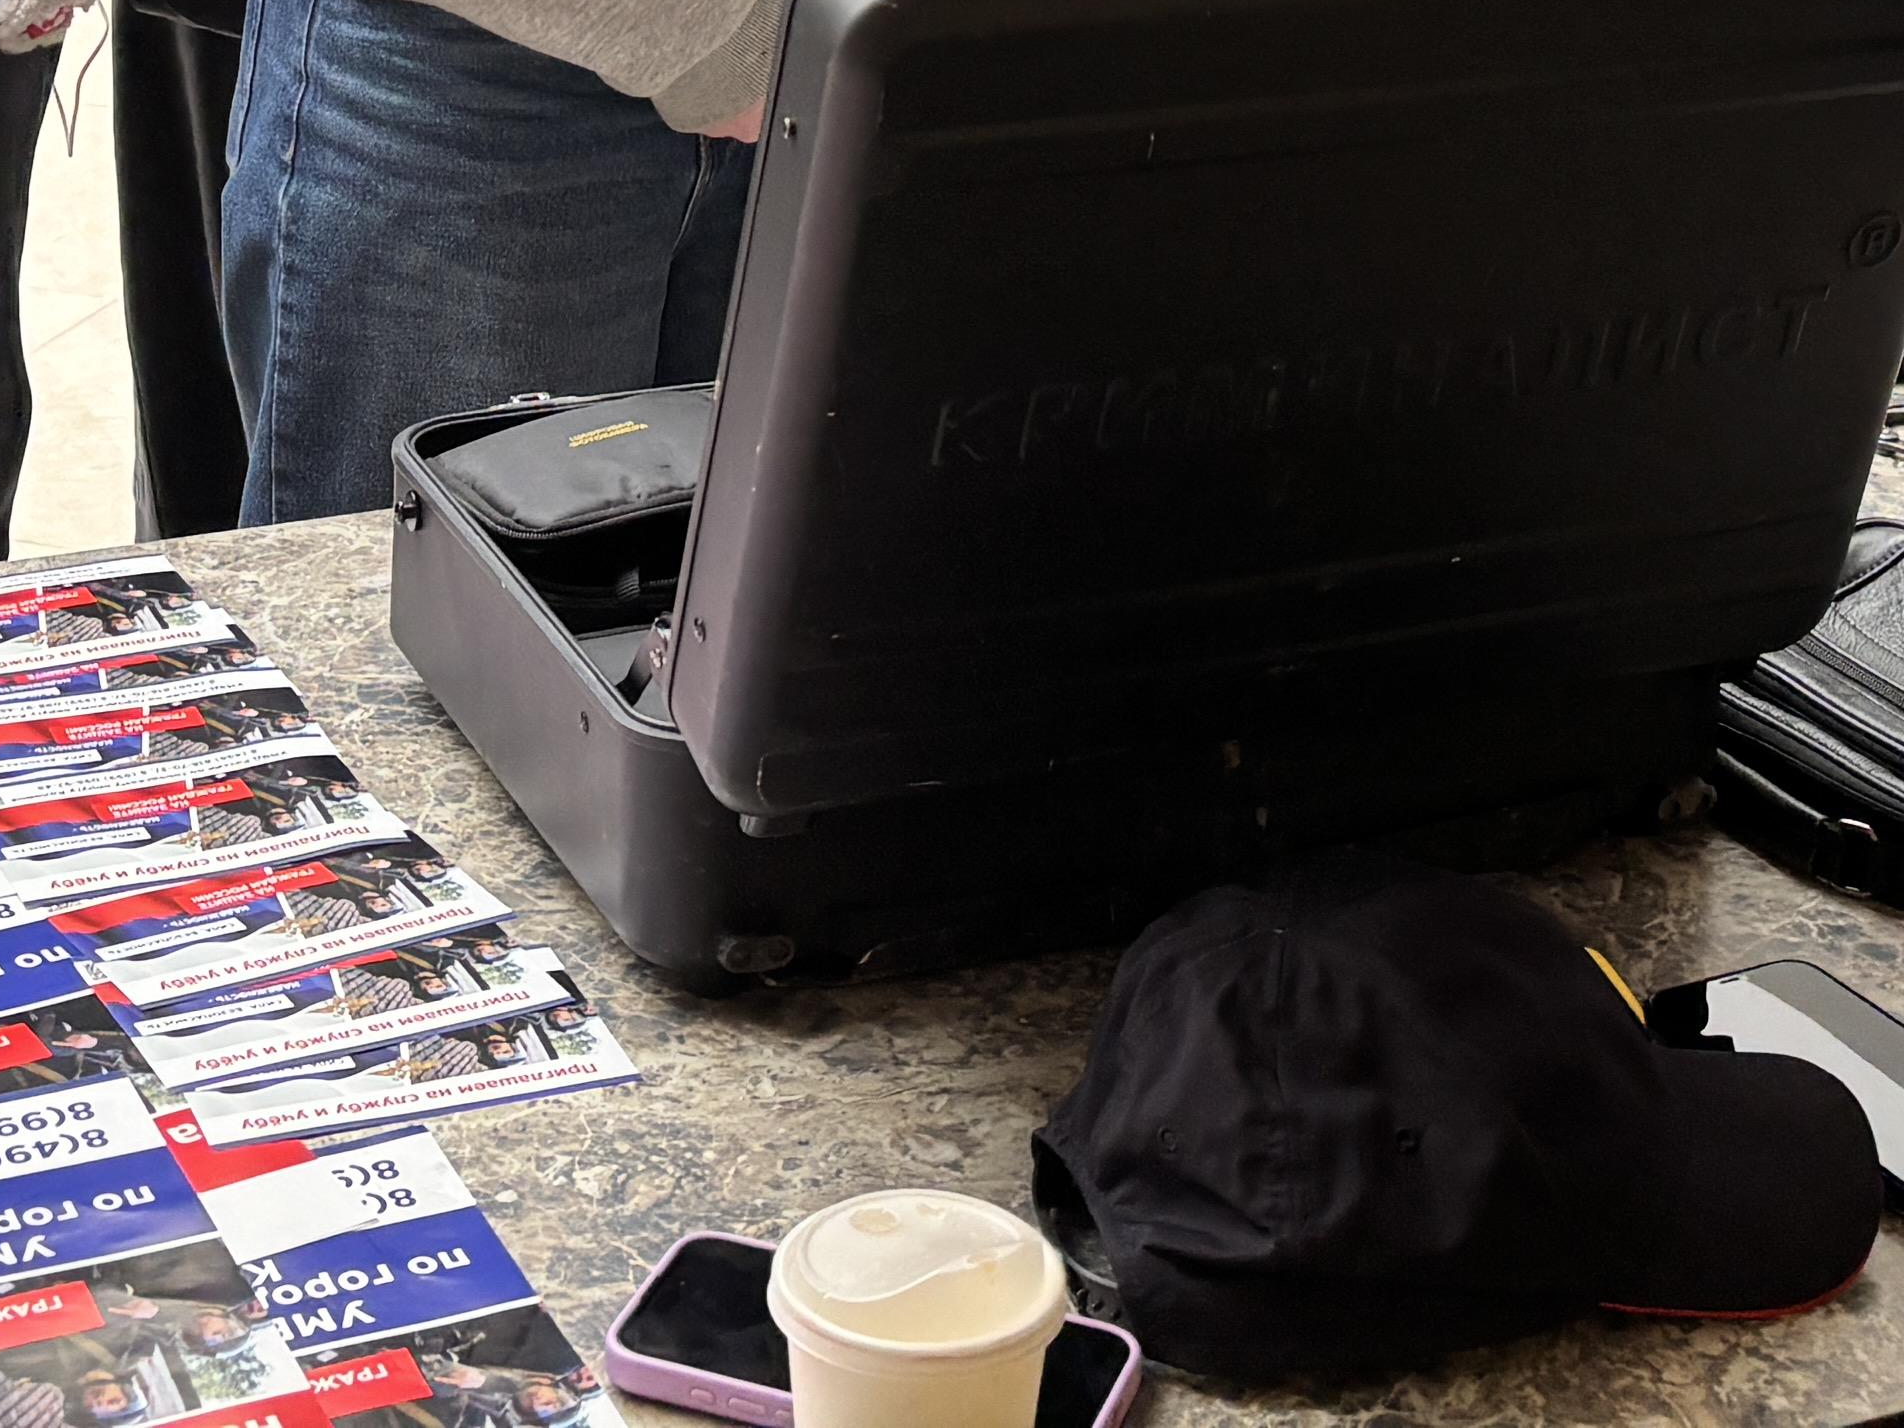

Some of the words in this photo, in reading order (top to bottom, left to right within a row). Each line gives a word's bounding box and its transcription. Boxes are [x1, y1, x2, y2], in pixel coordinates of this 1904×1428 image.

[135, 857, 211, 877] службу
[215, 853, 240, 863] на
[115, 870, 128, 878] и
[349, 907, 474, 943] Приглашаем
[321, 939, 345, 951] на
[14, 945, 72, 970] по
[243, 945, 317, 972] службу
[160, 969, 219, 991] учёбу
[224, 966, 237, 975] и
[398, 990, 530, 1026] Приглашаем
[368, 1021, 393, 1033] на
[263, 1046, 277, 1055] и
[283, 1028, 363, 1052] службу
[194, 1048, 258, 1071] учёбу
[458, 1063, 598, 1095] Приглашаем
[336, 1094, 420, 1114] службу
[425, 1087, 452, 1100] на
[242, 1109, 309, 1130] учёбу
[314, 1108, 329, 1117] и
[93, 1185, 156, 1210] по
[406, 1247, 472, 1276] по
